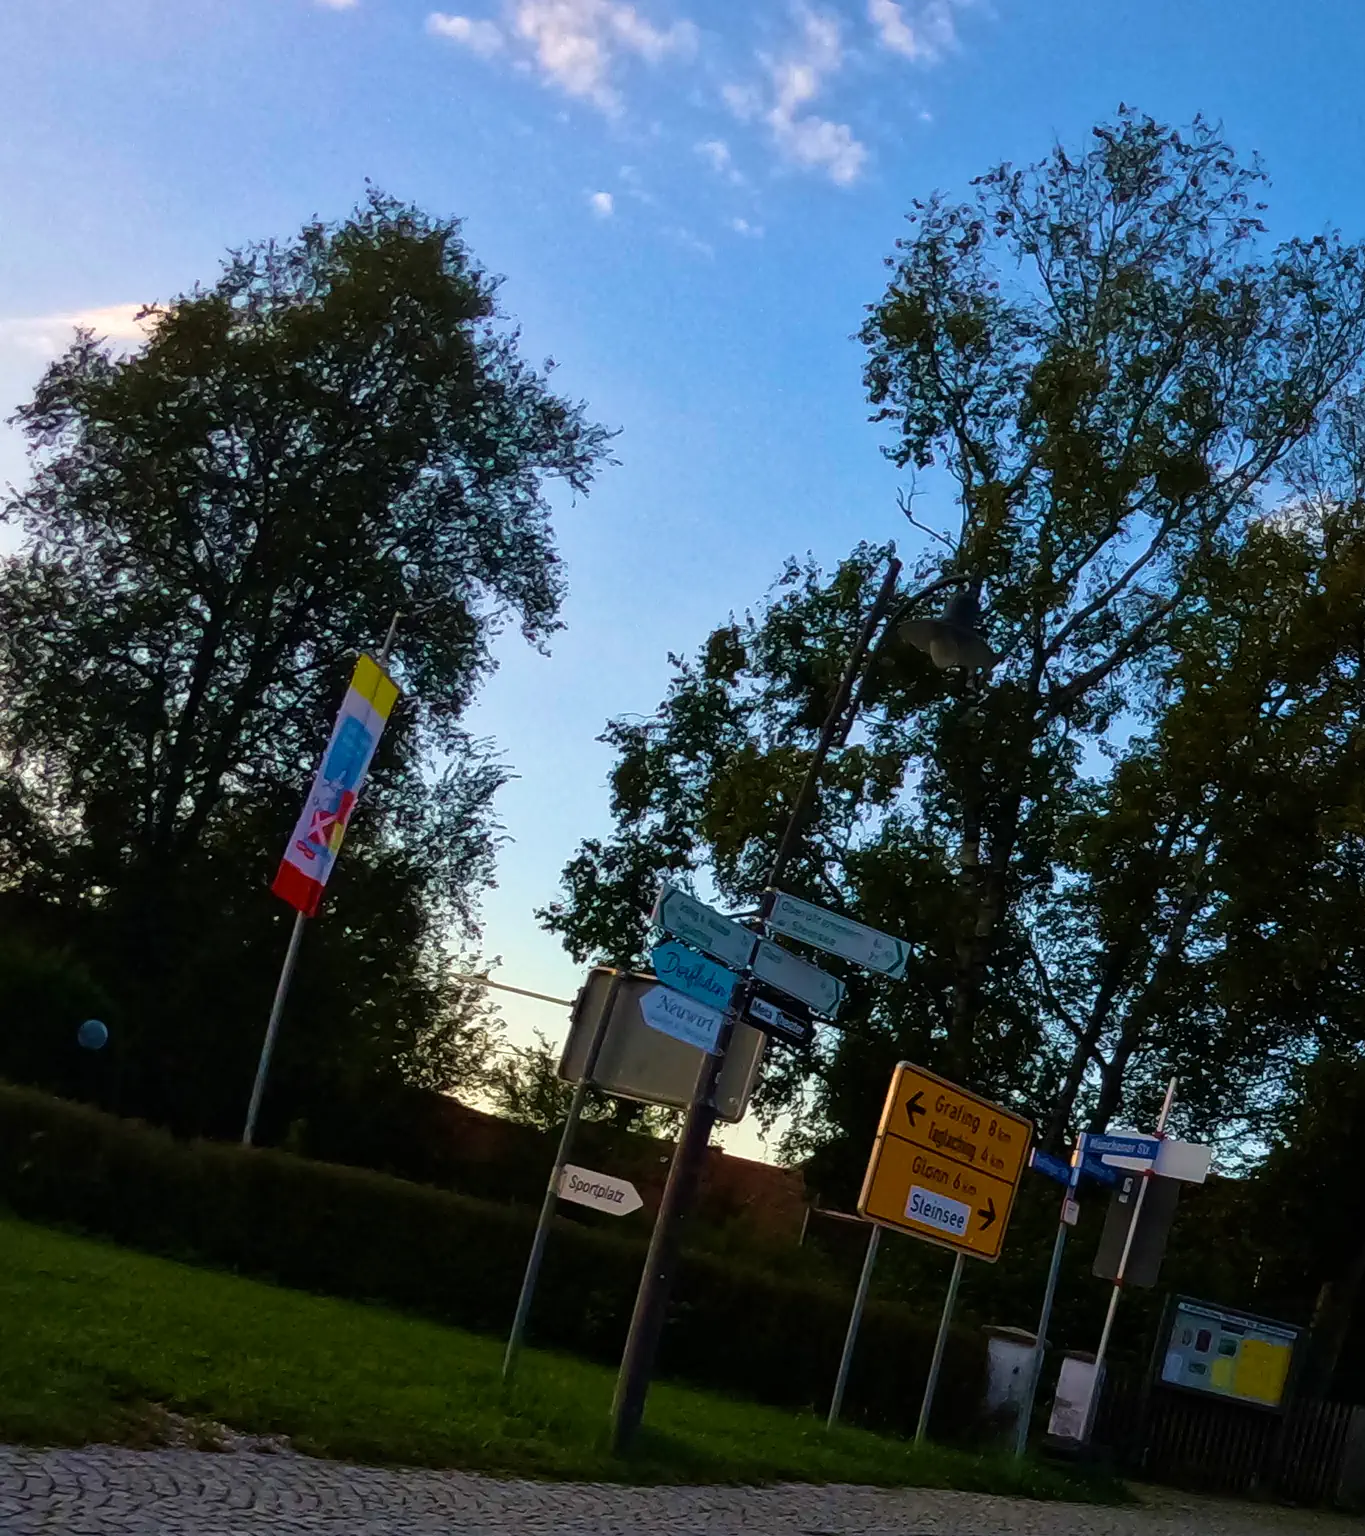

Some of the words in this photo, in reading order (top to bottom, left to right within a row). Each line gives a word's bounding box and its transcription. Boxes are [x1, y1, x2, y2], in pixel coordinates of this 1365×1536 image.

[935, 1094, 981, 1135] Grafing
[988, 1119, 998, 1137] 8
[980, 1145, 989, 1163] 4
[568, 1174, 626, 1204] Sportplatz
[911, 1155, 949, 1185] Glonn
[952, 1172, 962, 1190] 6
[909, 1193, 966, 1229] Steinsee
